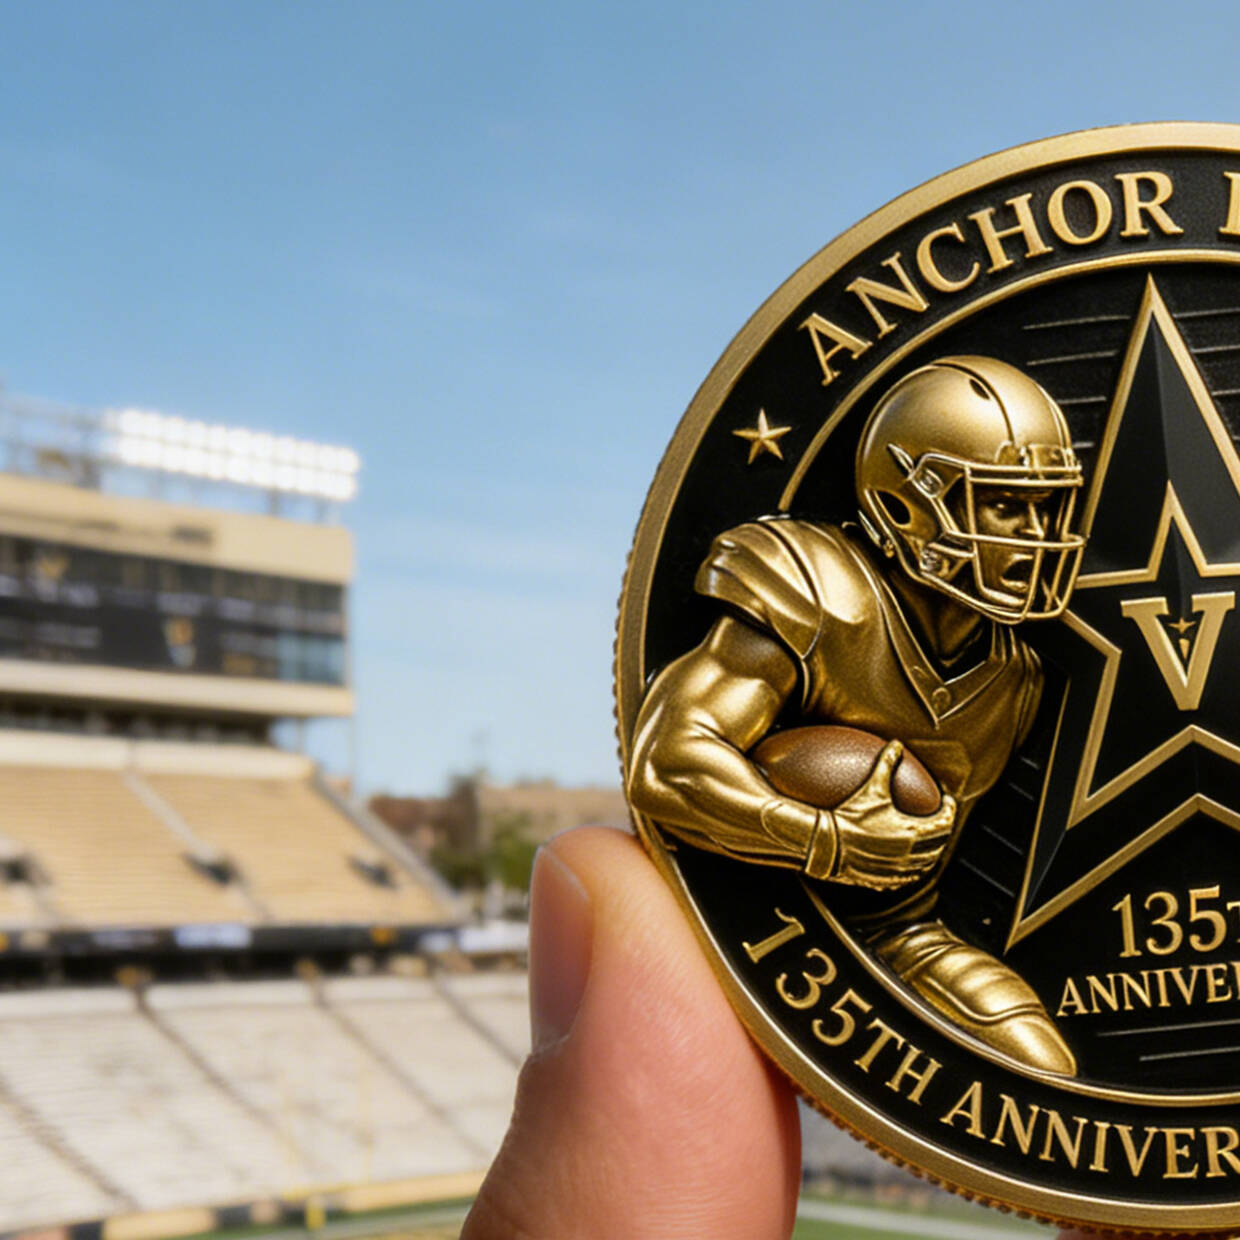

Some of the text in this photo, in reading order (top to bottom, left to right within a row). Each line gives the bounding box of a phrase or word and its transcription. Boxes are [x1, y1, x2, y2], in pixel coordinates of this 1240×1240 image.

[798, 170, 1184, 387] ANCHOR
[1120, 591, 1235, 711] V
[742, 907, 944, 1105] 135TH
